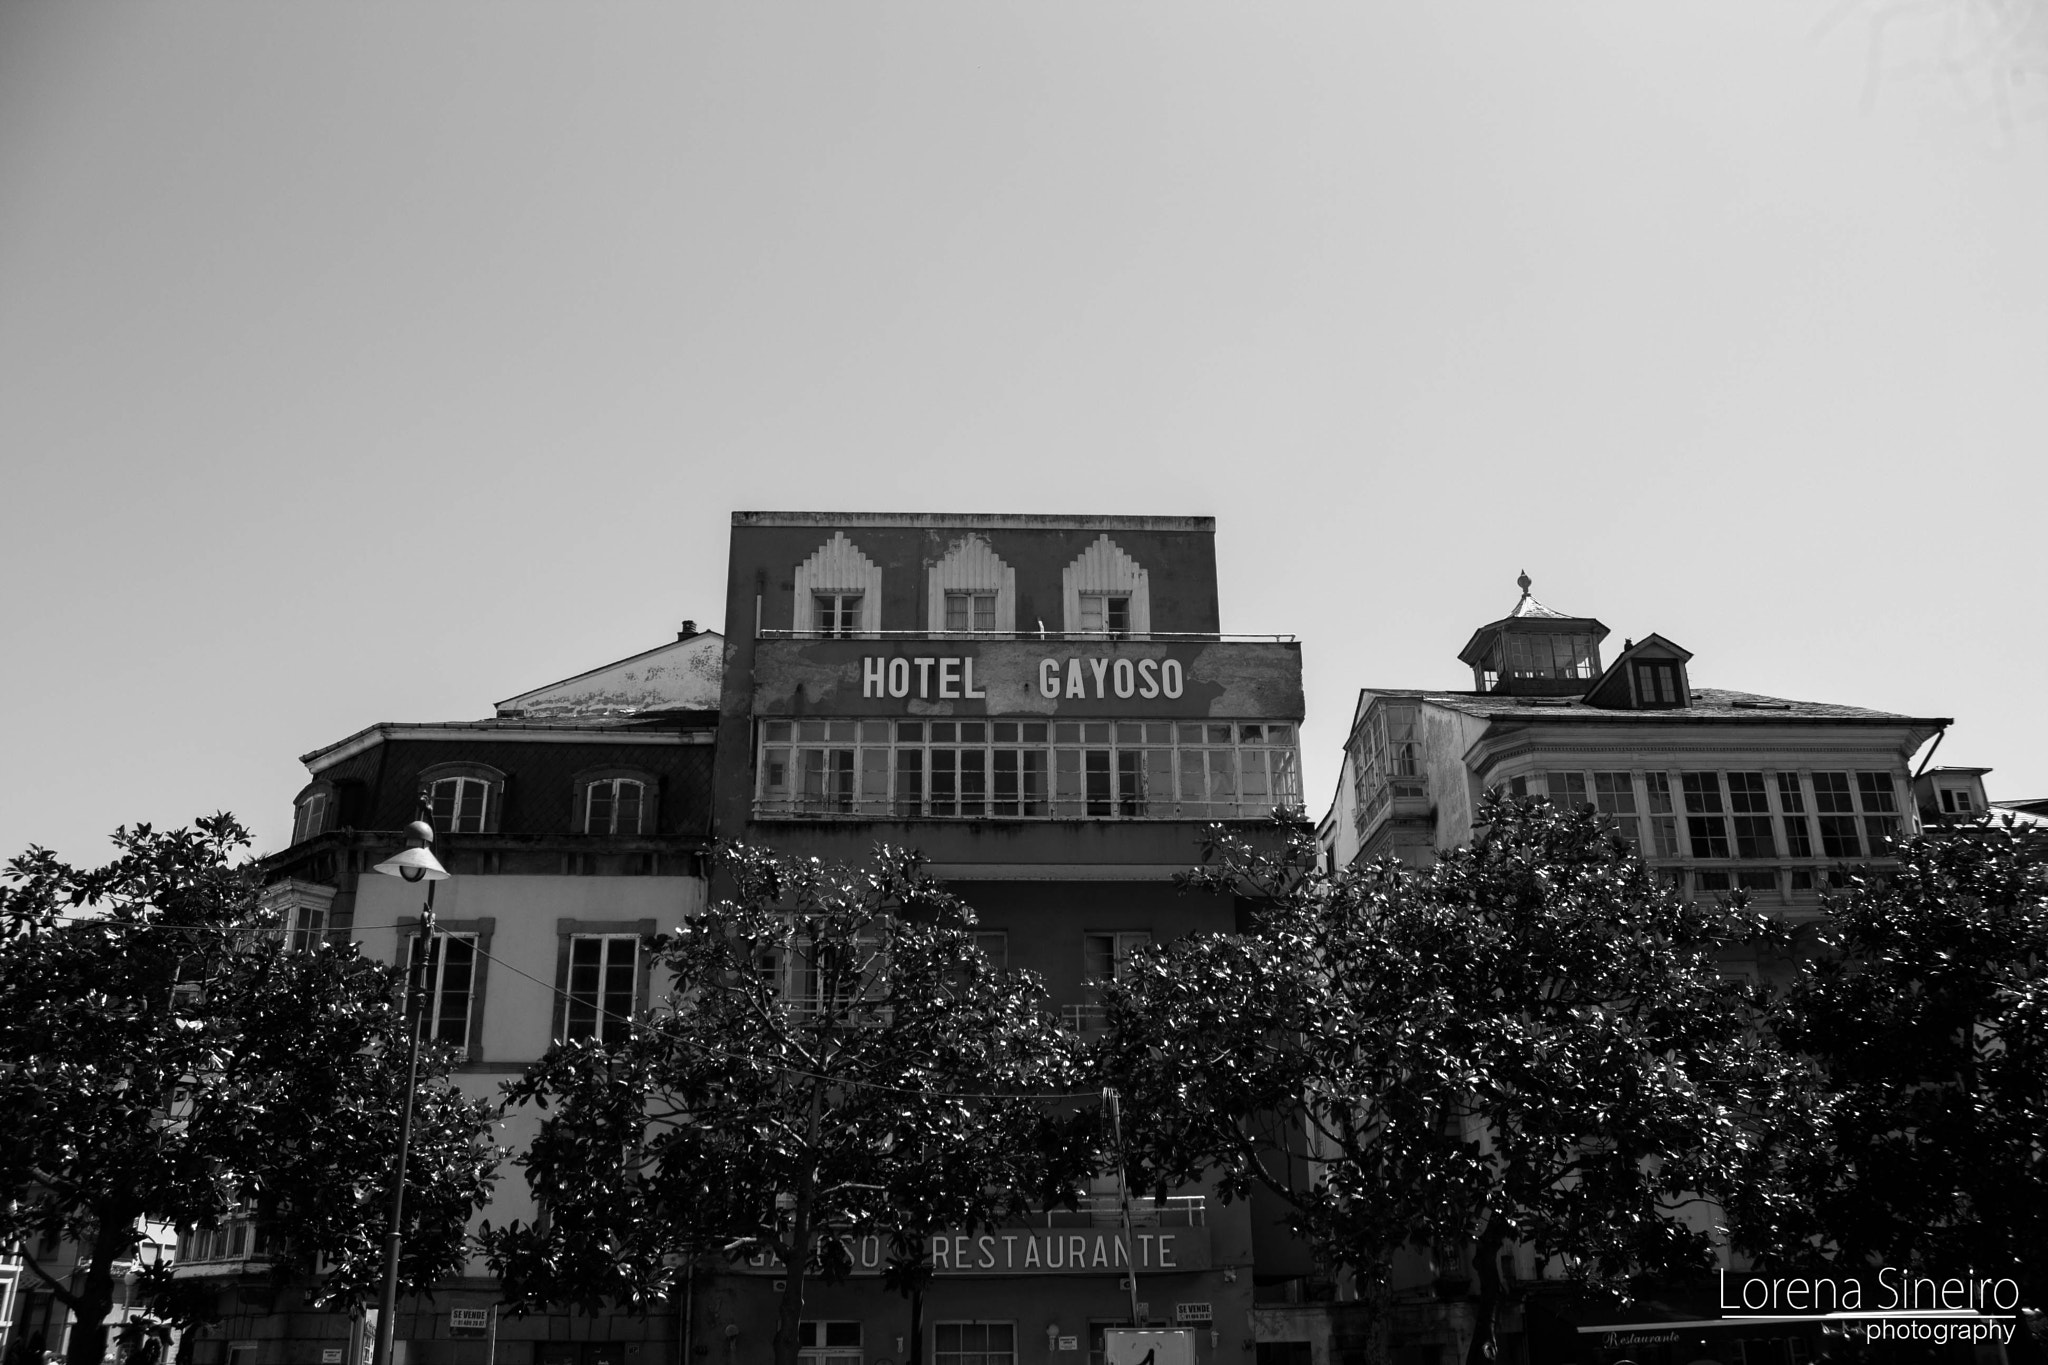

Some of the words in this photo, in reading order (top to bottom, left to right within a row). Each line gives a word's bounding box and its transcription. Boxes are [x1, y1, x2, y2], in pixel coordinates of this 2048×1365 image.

[863, 657, 986, 699] HOTEL
[1039, 658, 1184, 699] GAYOSO
[932, 1234, 1177, 1269] RESTAURANTE
[453, 1311, 462, 1319] SE
[463, 1311, 485, 1319] VENDE
[1178, 1305, 1187, 1313] SE
[1188, 1304, 1210, 1313] VENDE
[1602, 1331, 1680, 1349] Restaurante
